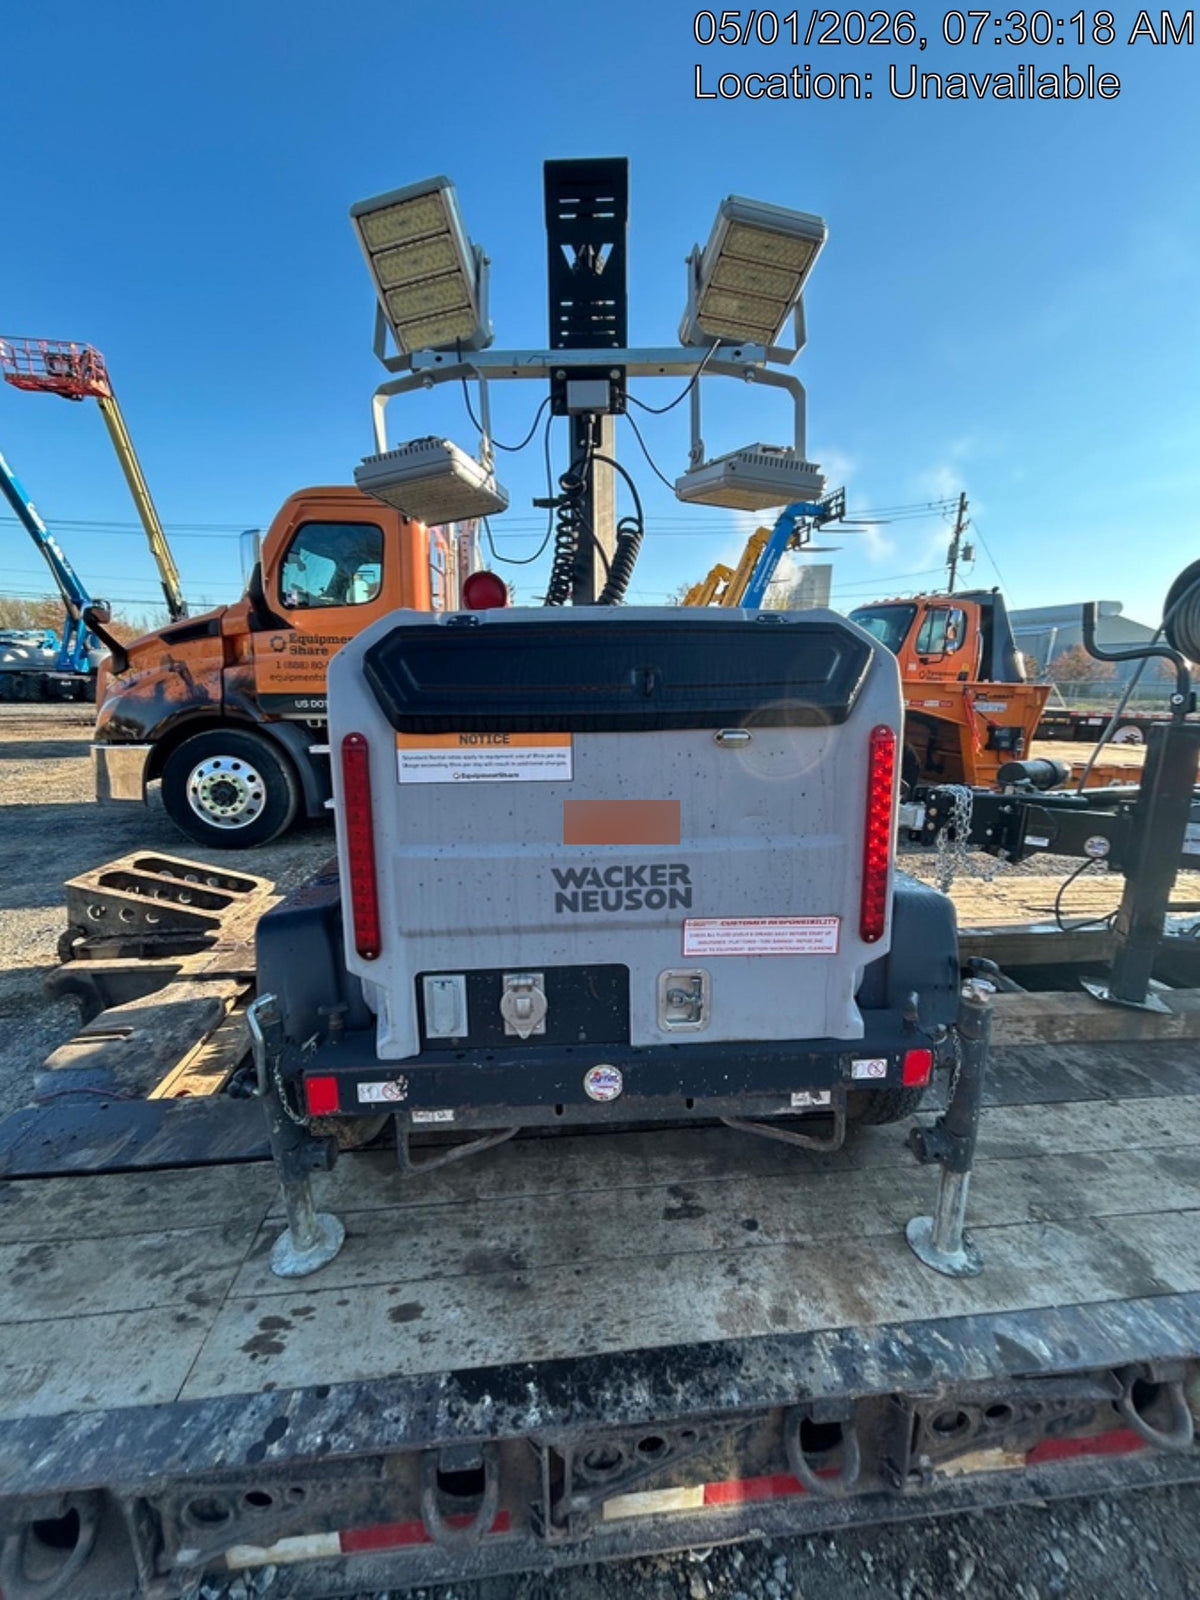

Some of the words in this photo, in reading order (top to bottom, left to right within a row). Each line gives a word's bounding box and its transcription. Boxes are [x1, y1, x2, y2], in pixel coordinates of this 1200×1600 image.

[289, 645, 329, 655] Share
[294, 699, 309, 708] US
[459, 733, 511, 745] NOTICE
[550, 864, 692, 890] WACKER
[555, 887, 692, 913] NEUSON
